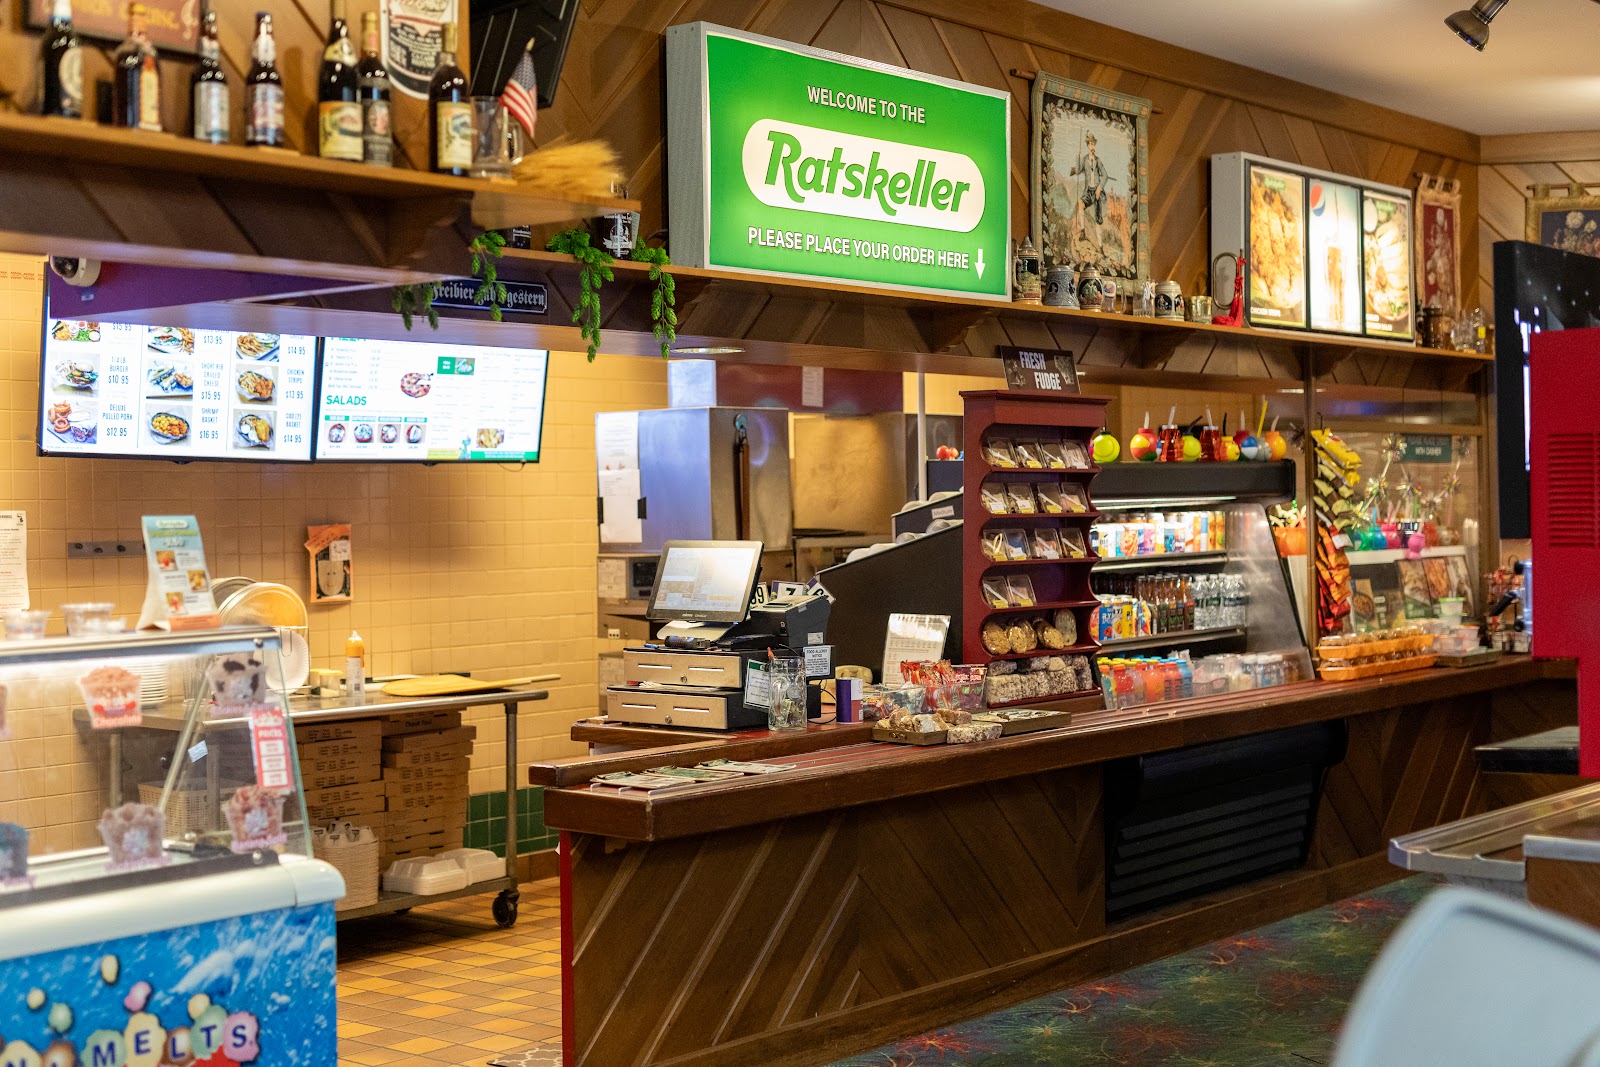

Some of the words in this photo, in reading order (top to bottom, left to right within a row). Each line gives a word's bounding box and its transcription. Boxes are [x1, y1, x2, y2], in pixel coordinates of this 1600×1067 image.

[807, 85, 877, 115] WELCOME
[879, 100, 897, 118] TO
[900, 103, 926, 124] THE
[764, 130, 970, 216] Ratskeller
[748, 226, 803, 250] PLEASE
[806, 233, 851, 256] PLACE
[852, 239, 890, 260] YOUR
[893, 244, 935, 266] ORDER
[938, 250, 969, 269] HERE
[507, 289, 545, 308] gestern
[1019, 351, 1046, 370] FRESH
[1034, 371, 1062, 390] FUDGE
[109, 403, 126, 412] DELUXE
[326, 395, 367, 406] SALADS
[201, 407, 219, 415] SHRIMP
[201, 416, 218, 424] BASKET
[93, 1024, 248, 1067] MELTS
